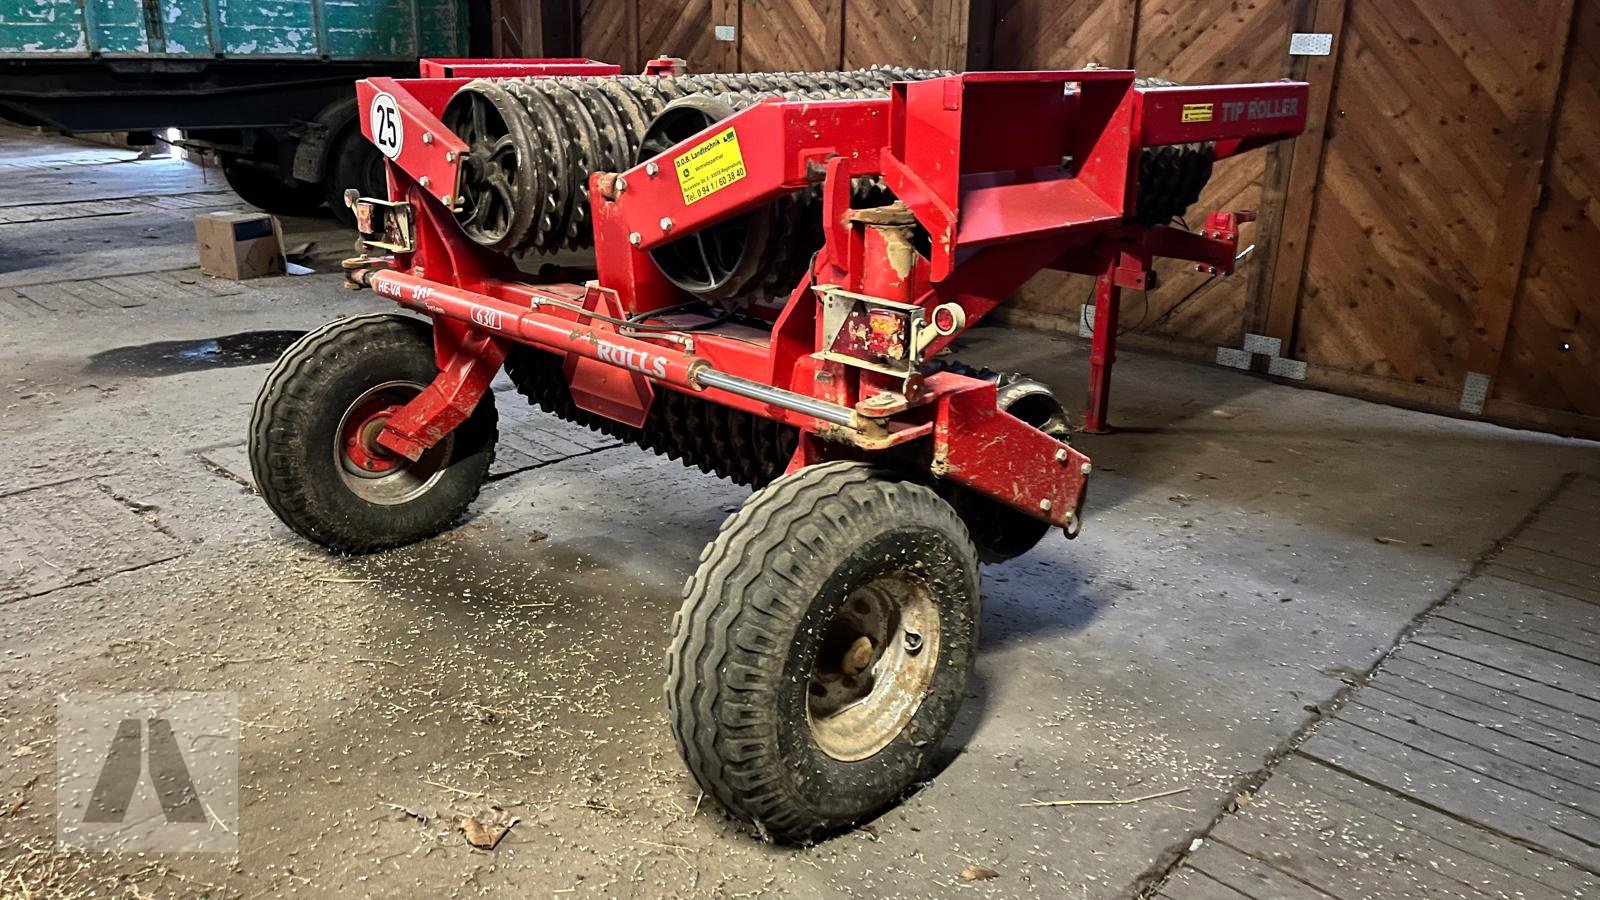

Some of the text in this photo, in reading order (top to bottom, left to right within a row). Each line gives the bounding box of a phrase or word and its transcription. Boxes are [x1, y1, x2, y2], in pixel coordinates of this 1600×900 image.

[1222, 101, 1244, 121] TIP
[1248, 98, 1298, 119] ROLLER
[377, 105, 396, 148] 25
[676, 139, 720, 167] D.O.B. Landtechnik
[686, 192, 696, 202] Tel.
[697, 189, 701, 197] 0
[702, 185, 709, 194] 94
[719, 176, 726, 186] 60
[727, 172, 735, 181] 38
[736, 167, 744, 177] 40
[378, 281, 401, 297] HE-VA
[476, 310, 496, 327] 630
[597, 341, 667, 378] ROLLS
